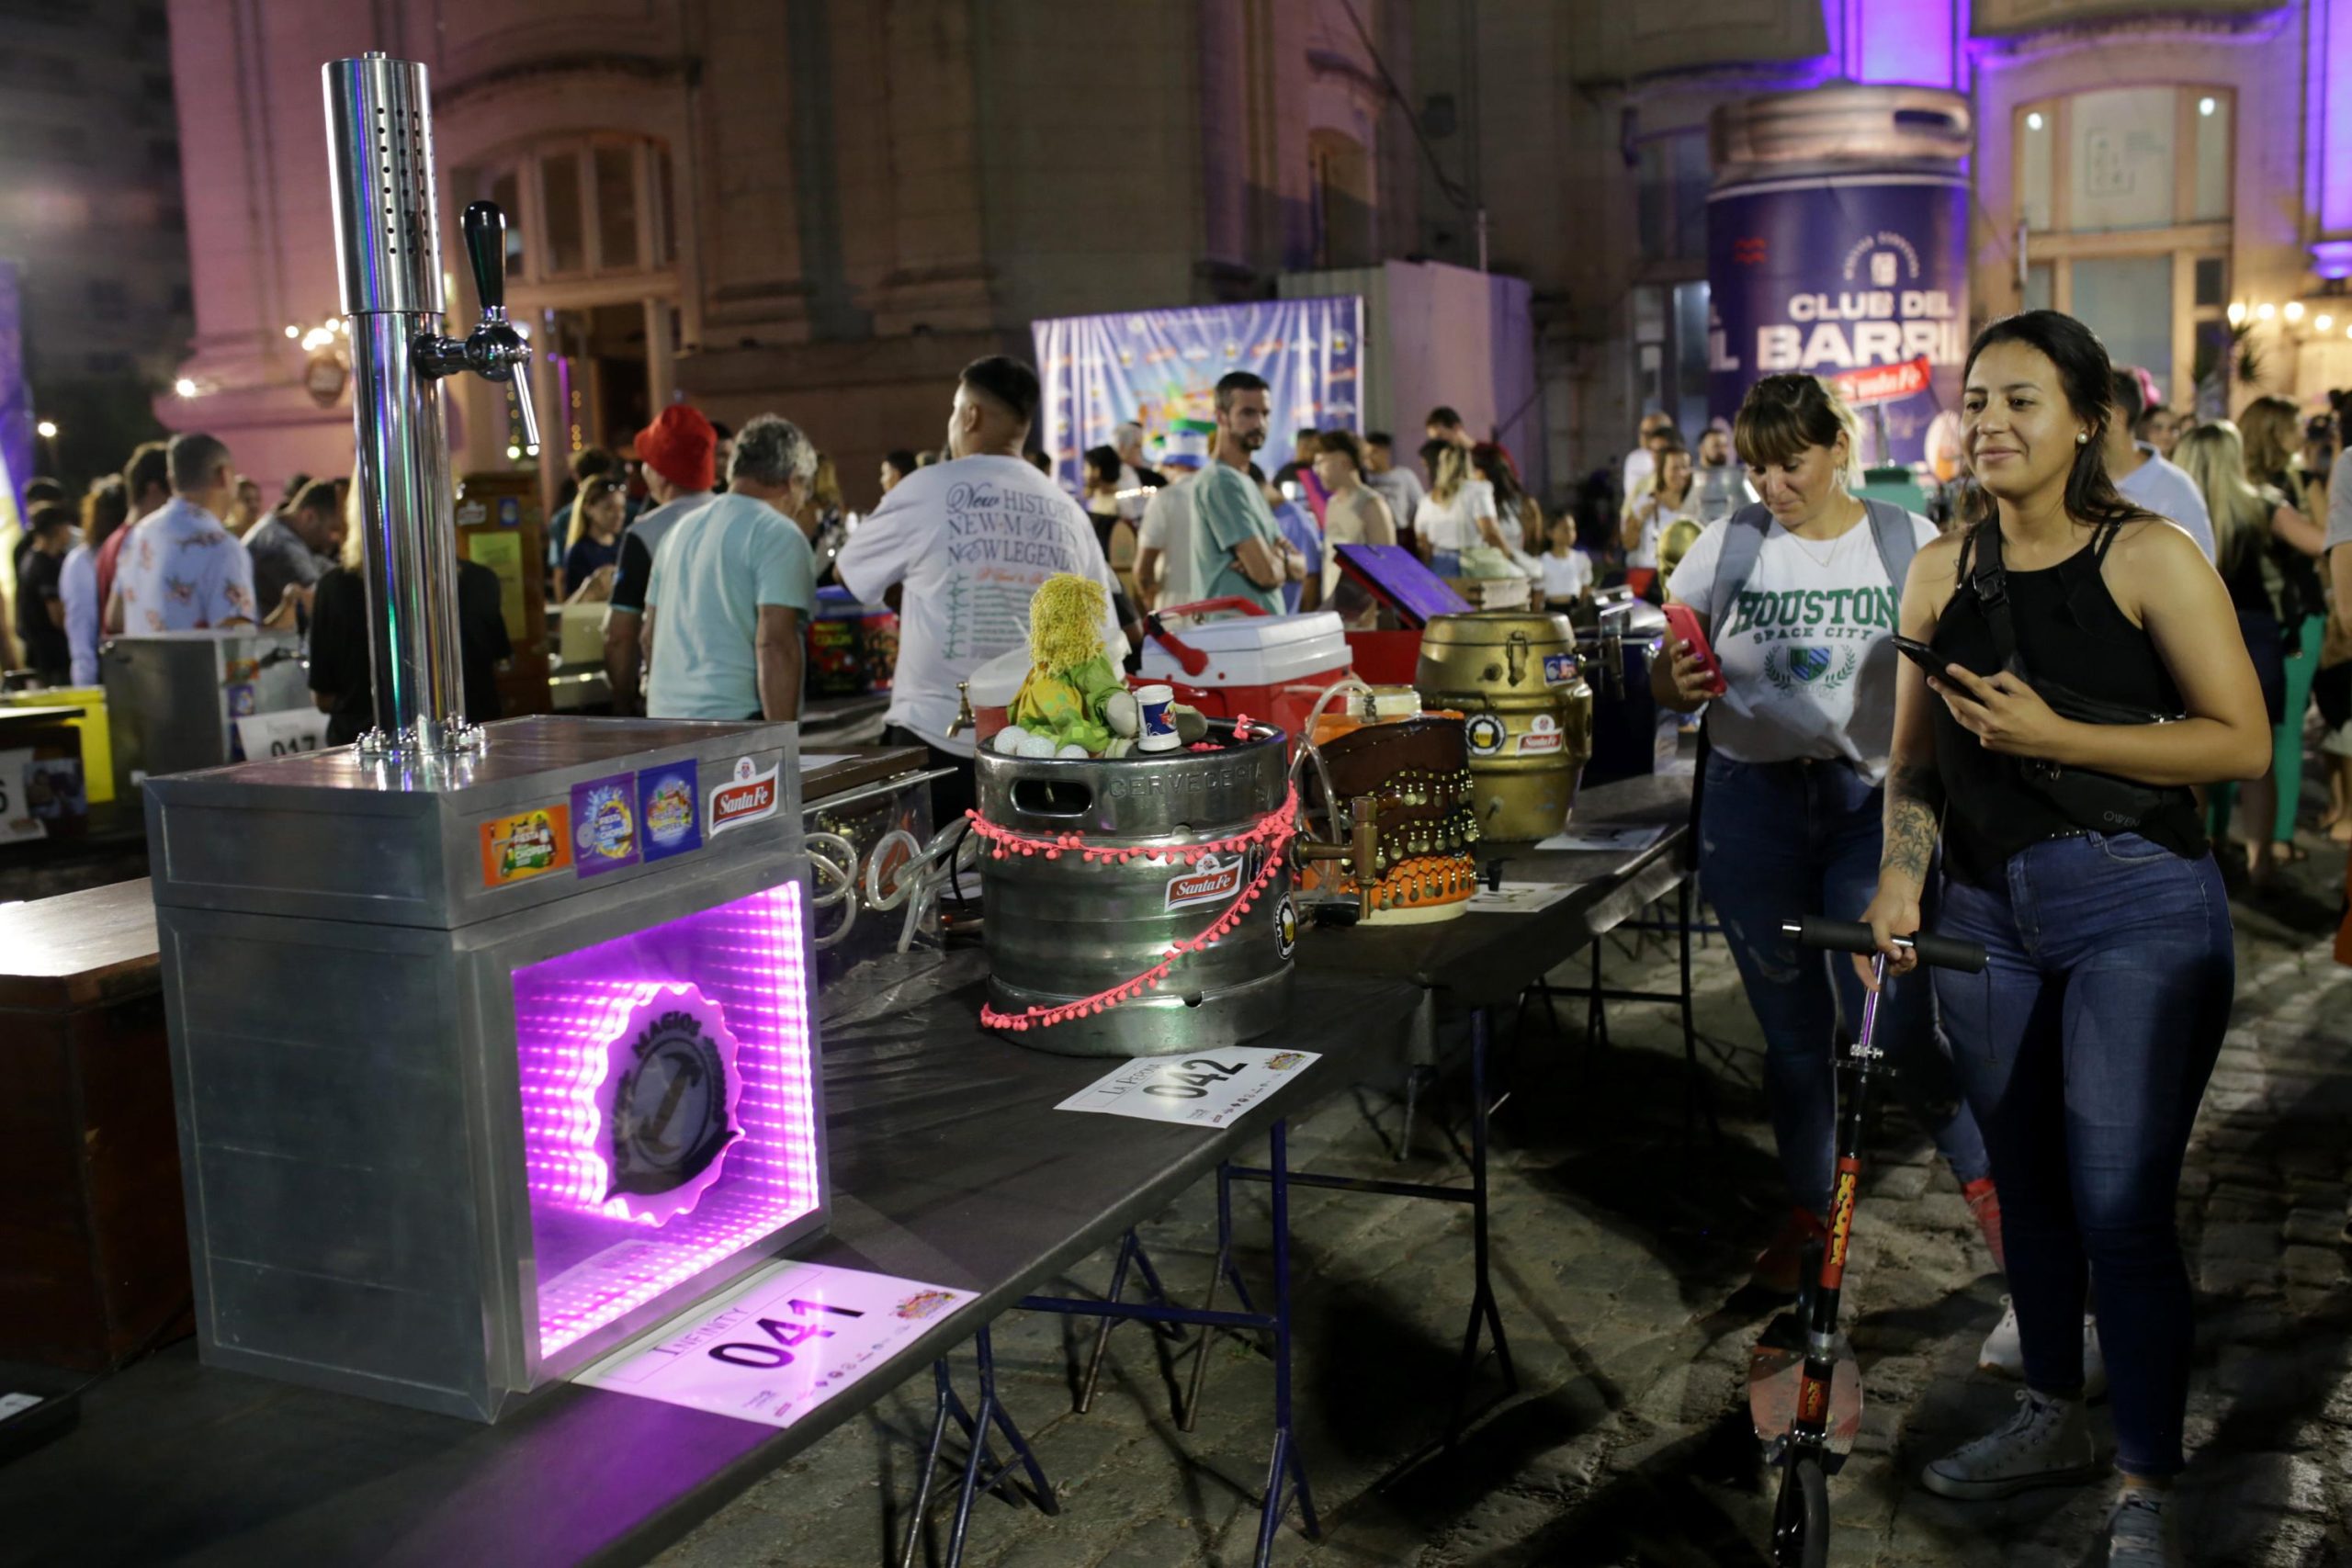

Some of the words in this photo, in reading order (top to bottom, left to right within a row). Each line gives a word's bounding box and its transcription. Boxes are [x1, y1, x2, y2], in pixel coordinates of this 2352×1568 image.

[1788, 291, 1894, 321] CLUB
[1900, 289, 1954, 319] DEL
[946, 481, 1000, 514] New
[1728, 585, 1899, 637] HOUSTON
[1753, 627, 1815, 644] SPACE
[1825, 626, 1873, 641] CITY
[1098, 1080, 1126, 1096] LA
[1143, 1059, 1249, 1099] 042
[707, 1298, 865, 1369] 041
